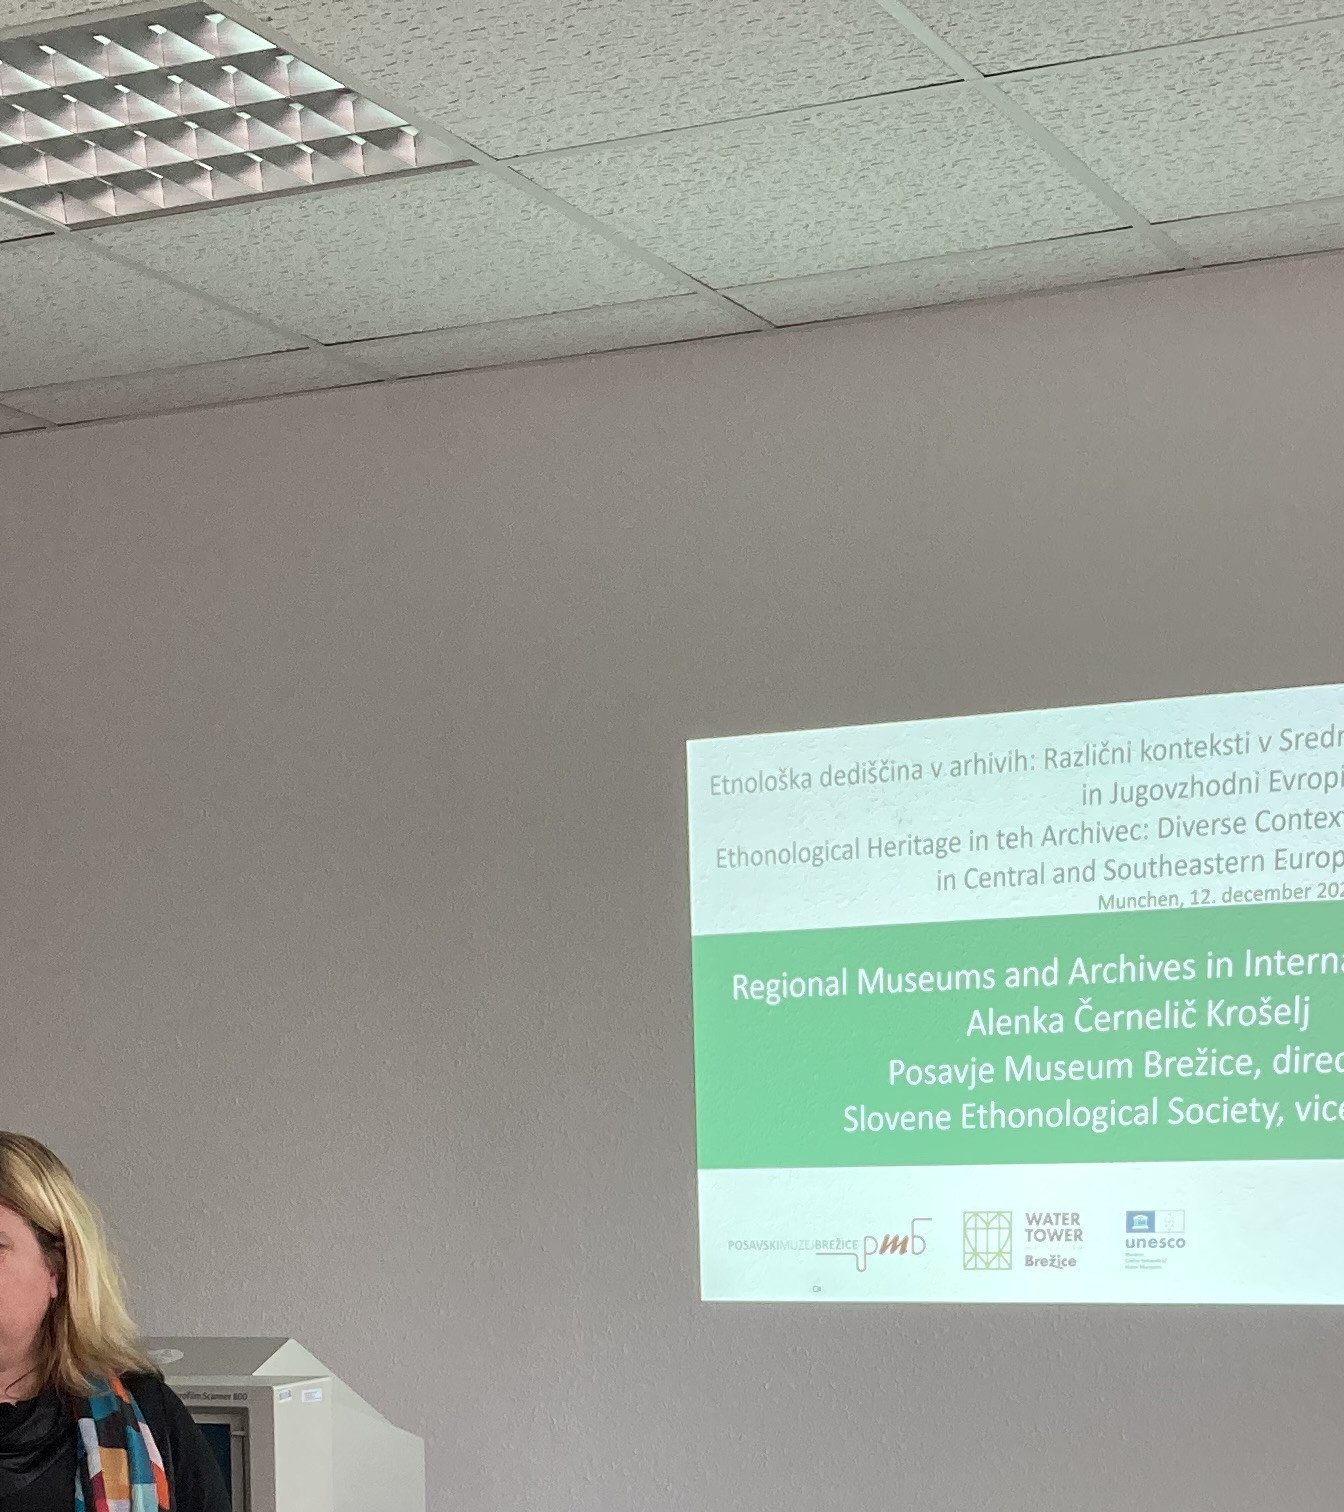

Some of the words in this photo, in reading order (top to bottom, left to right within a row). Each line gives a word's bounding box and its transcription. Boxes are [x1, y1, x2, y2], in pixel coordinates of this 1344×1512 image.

[710, 767, 812, 796] Etnološka
[820, 759, 923, 788] dediščina
[931, 761, 943, 777] v
[950, 749, 1036, 776] arhivih:
[1044, 741, 1132, 770] Različni
[1141, 731, 1250, 763] konteksti
[1258, 734, 1272, 752] v
[1082, 783, 1102, 806] in
[1109, 771, 1260, 808] Jugovzhodni
[716, 836, 860, 869] Ethonological
[868, 832, 961, 860] Heritage
[969, 829, 988, 851] in
[997, 825, 1033, 850] teh
[1158, 813, 1247, 840] Diverse
[937, 869, 956, 891] in
[964, 862, 1045, 889] Central
[1053, 859, 1096, 885] and
[1104, 854, 1265, 882] Southeastern
[1098, 890, 1184, 911] Munchen,
[1190, 888, 1216, 906] 12.
[1222, 883, 1312, 904] december
[733, 967, 848, 1006] Regional
[858, 965, 996, 996] Museums
[1005, 956, 1059, 987] and
[1068, 953, 1196, 986] Archives
[1206, 951, 1234, 979] in
[966, 1005, 1064, 1036] Alenka
[1074, 997, 1197, 1033] Černelič
[1207, 995, 1311, 1032] Krošelj
[889, 1056, 995, 1091] Posavje
[1005, 1054, 1133, 1083] Museum
[1144, 1047, 1261, 1081] Brežice,
[843, 1105, 952, 1133] Slovene
[961, 1097, 1158, 1134] Ethonological
[1168, 1096, 1285, 1130] Society,
[1025, 1212, 1081, 1226] WATER
[1025, 1228, 1084, 1242] TOWER
[1024, 1254, 1077, 1269] Brežice
[1125, 1237, 1186, 1249] unesco
